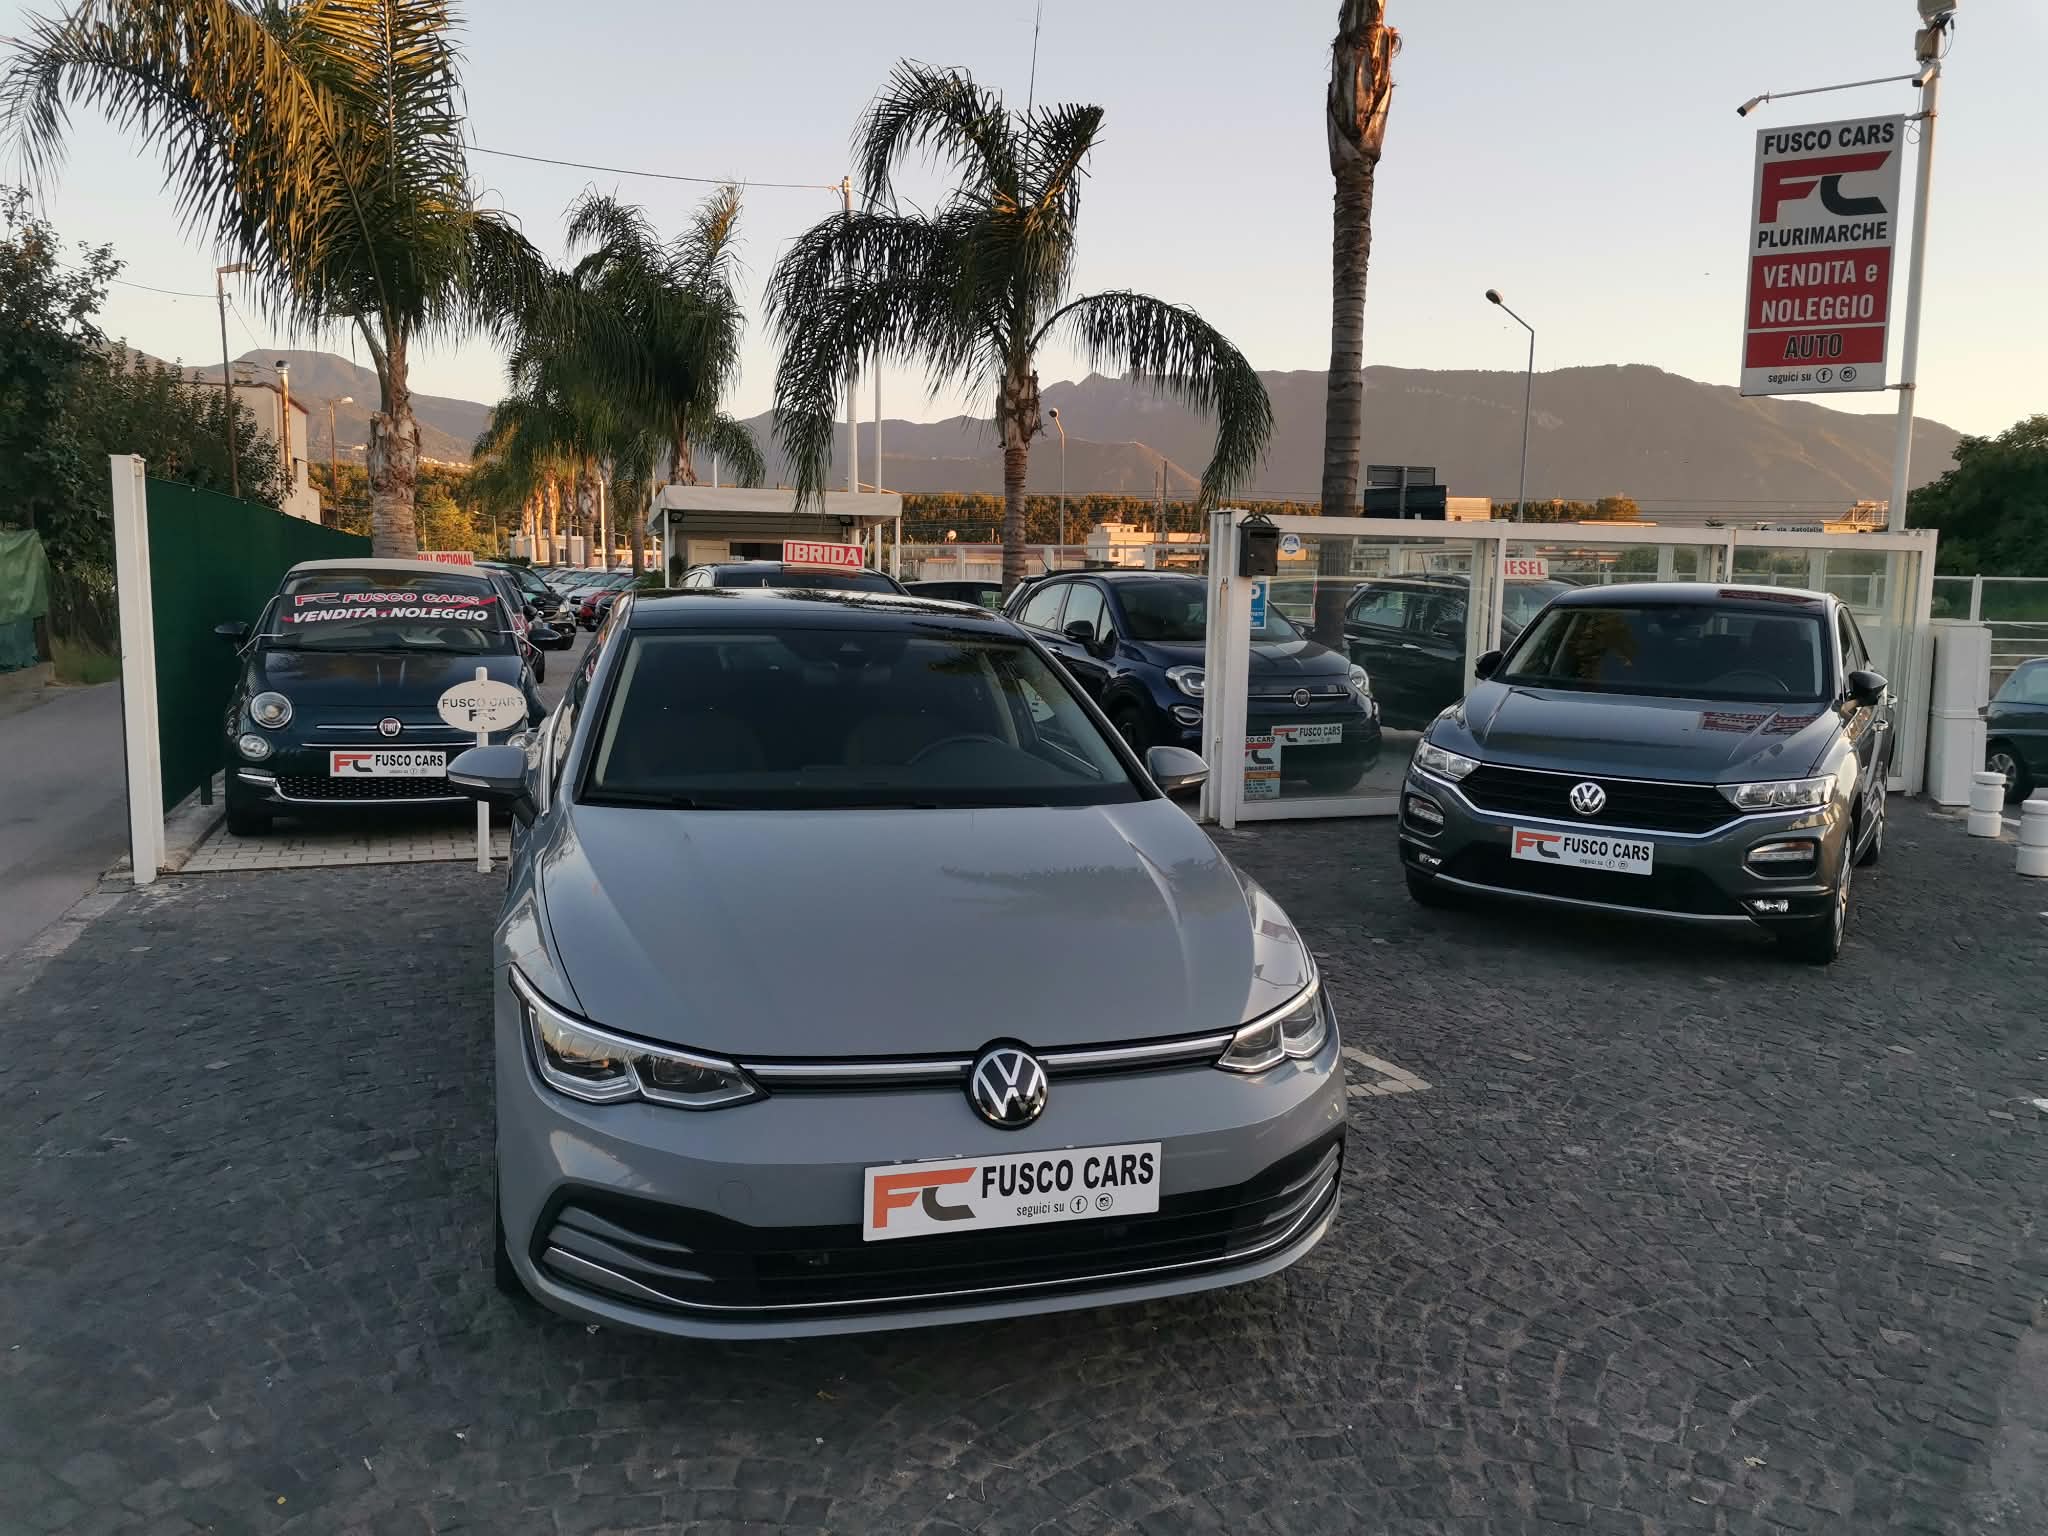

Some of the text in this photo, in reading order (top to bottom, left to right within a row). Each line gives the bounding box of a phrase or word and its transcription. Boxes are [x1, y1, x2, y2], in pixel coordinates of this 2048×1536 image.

[1763, 122, 1895, 155] FUSCO CARS
[1757, 221, 1888, 249] PLURIMARCHE
[1763, 260, 1878, 289] VENDITA e
[1761, 294, 1874, 323] NOLEGGIO
[1784, 333, 1843, 360] AUTO
[1768, 372, 1812, 385] seguici su
[436, 554, 472, 566] OPTIONAL
[787, 543, 860, 565] IBRIDA
[1504, 561, 1545, 576] IESEL
[343, 593, 417, 604] FUSCO
[422, 594, 479, 605] CARS
[293, 608, 377, 623] VENDITA
[391, 608, 488, 621] NOLEGGIO
[1300, 726, 1341, 737] FUSCO CARS
[375, 754, 443, 767] FUSCO CARS
[1563, 837, 1650, 861] FUSCO CARS
[981, 1152, 1154, 1199] FUSCO CARS
[1016, 1202, 1065, 1219] seguici su
